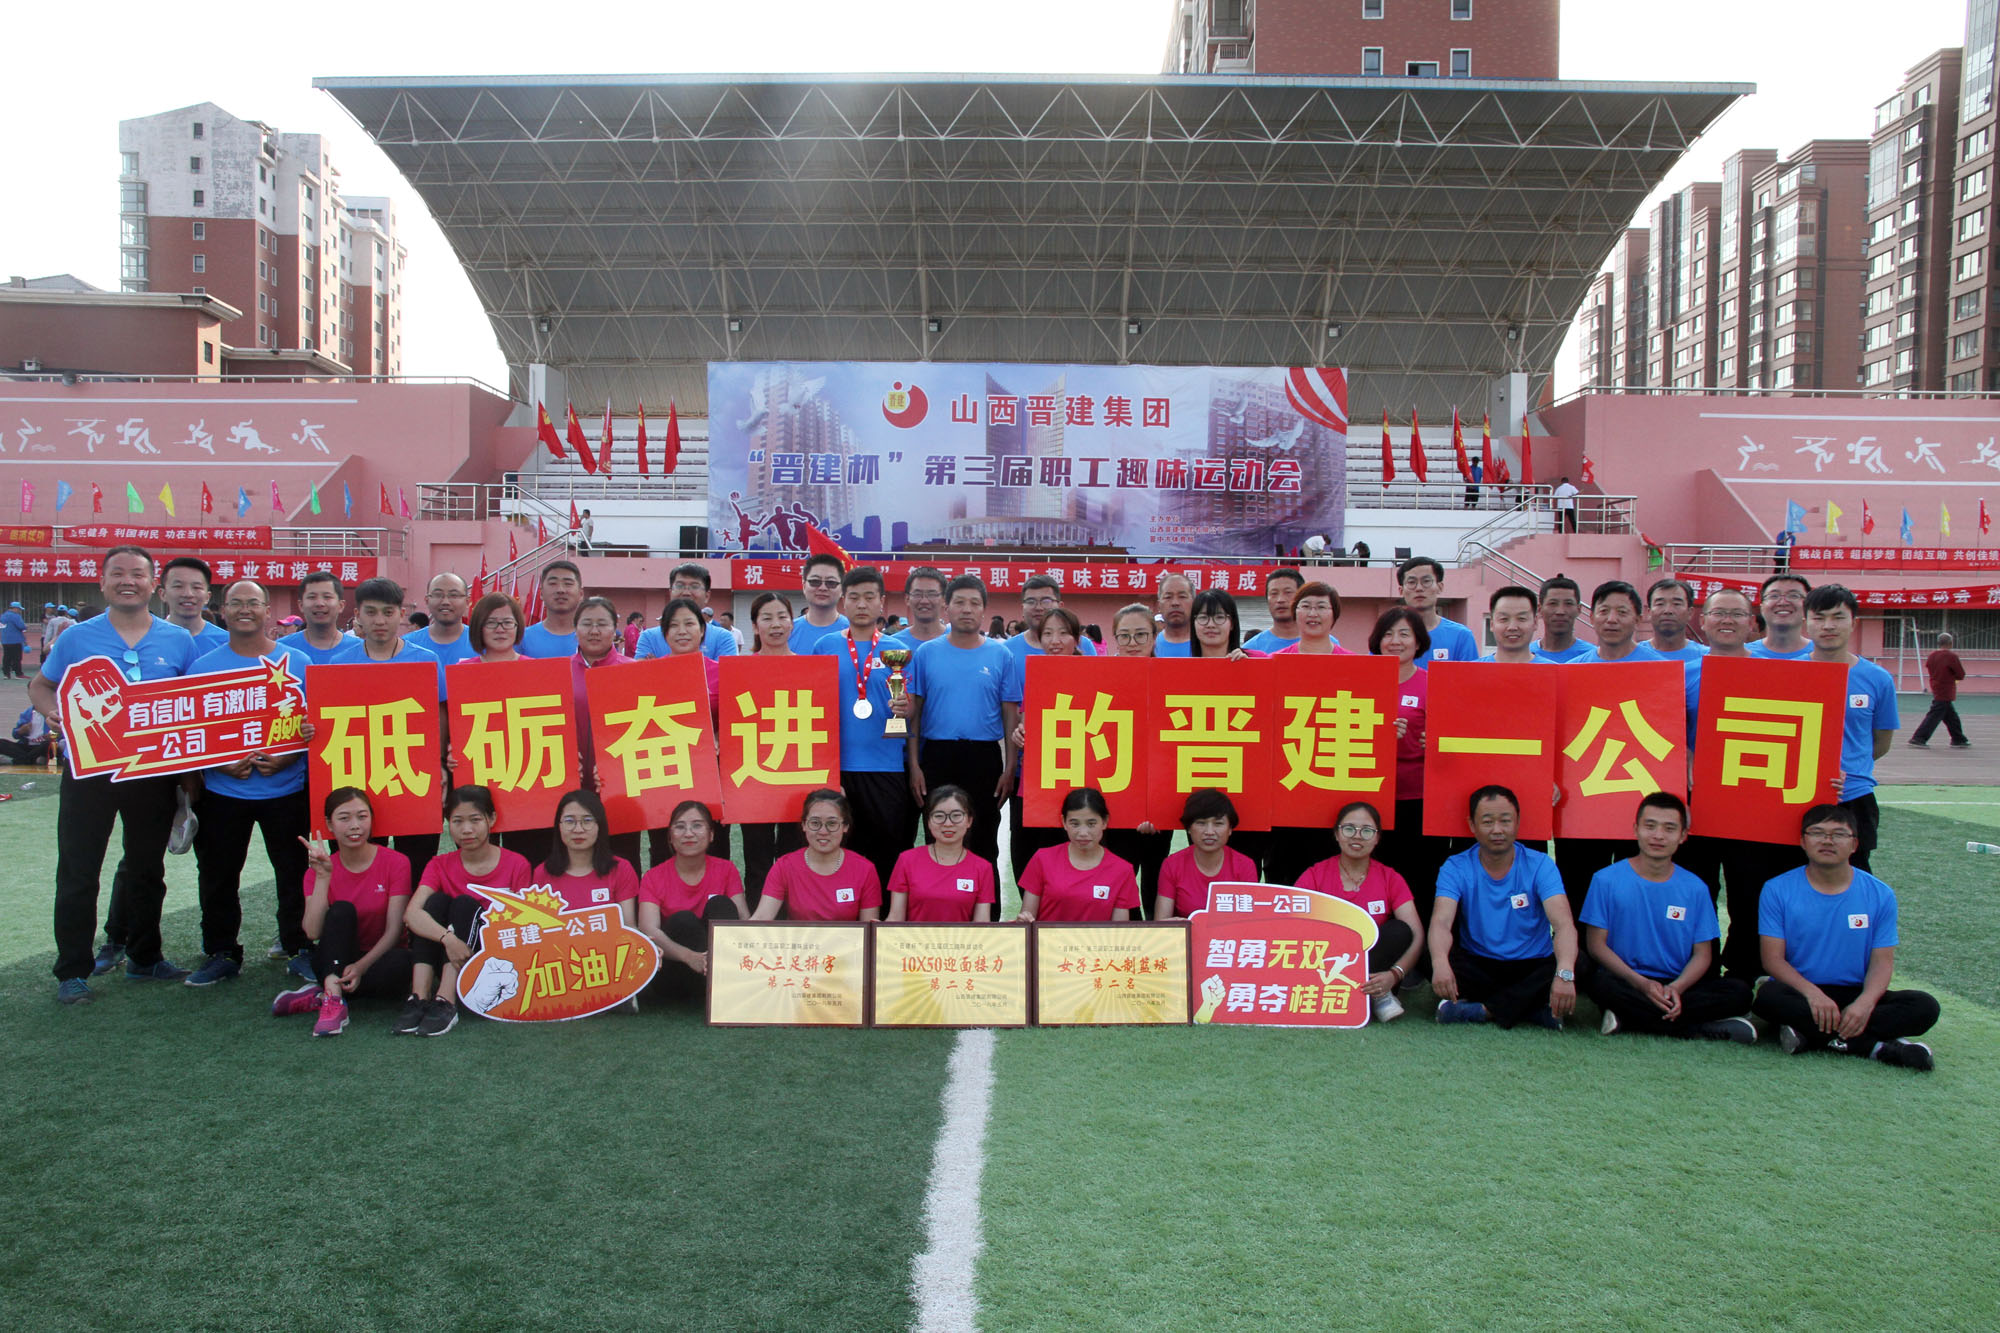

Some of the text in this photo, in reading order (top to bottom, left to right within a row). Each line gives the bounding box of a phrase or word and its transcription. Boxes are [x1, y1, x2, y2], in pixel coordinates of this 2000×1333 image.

[951, 393, 1170, 428] 山西晋建集团
[114, 528, 160, 540] 利国利民
[165, 529, 208, 540] 功在当代
[213, 530, 257, 540] 利在千秋
[1798, 548, 2000, 561] 挑战自我 超越梦想 团结互助 共创佳绩
[4, 558, 98, 578] 精神风貌
[129, 685, 267, 729] 有信心 有激情
[137, 693, 305, 759] 一公司 一定 赢
[1215, 893, 1311, 914] 晋建一公司
[497, 913, 608, 949] 晋建一公司
[738, 954, 837, 973] 两人三足拼字
[1206, 938, 1331, 970] 智勇无双
[1056, 956, 1168, 975] 女子三人制篮球
[767, 976, 812, 990] 第二名
[930, 977, 975, 991] 第二名
[1092, 976, 1136, 991] 第二名
[1225, 982, 1352, 1014] 勇夺桂冠
